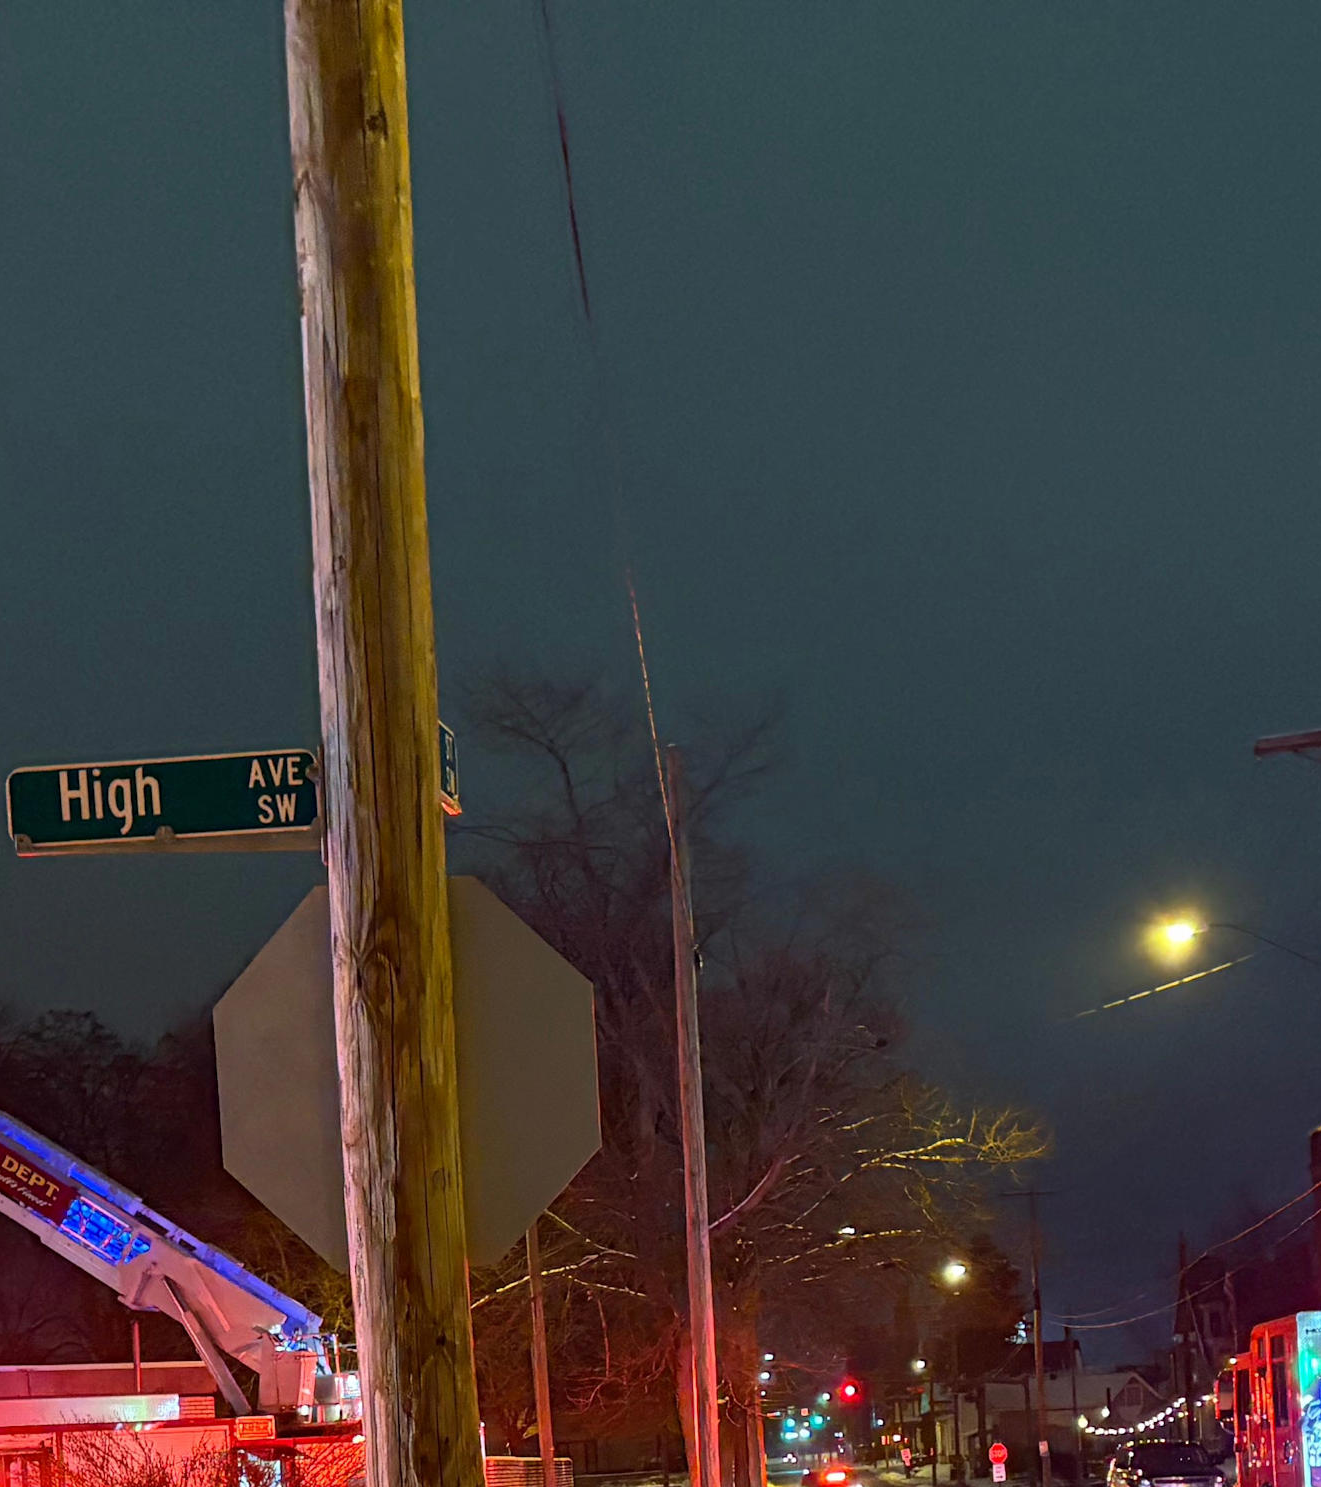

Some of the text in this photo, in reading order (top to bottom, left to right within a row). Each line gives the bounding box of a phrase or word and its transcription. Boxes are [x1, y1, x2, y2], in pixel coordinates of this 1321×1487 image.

[248, 756, 304, 789] AVE
[58, 766, 162, 835] High
[257, 793, 297, 824] SW
[1, 1154, 60, 1201] DEPT.
